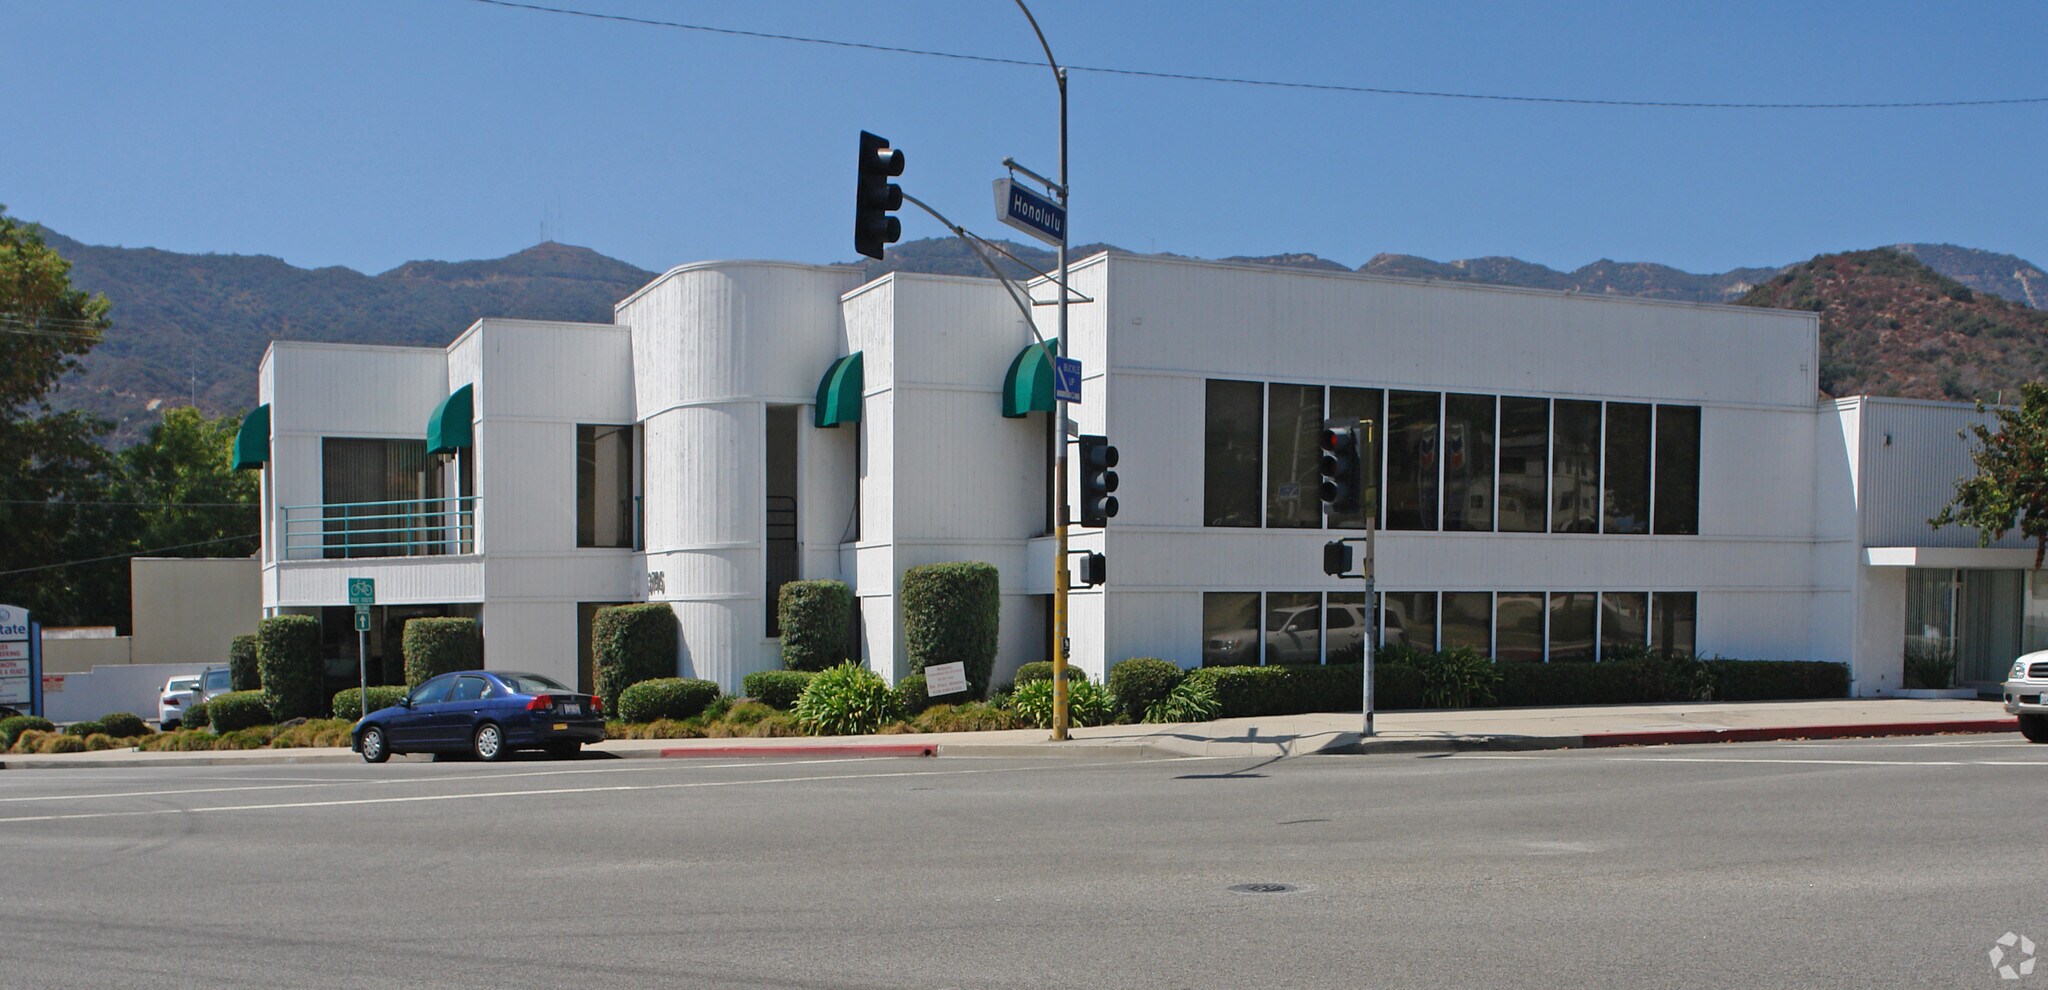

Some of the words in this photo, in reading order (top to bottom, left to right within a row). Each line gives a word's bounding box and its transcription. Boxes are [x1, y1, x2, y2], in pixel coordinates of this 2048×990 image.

[1014, 194, 1061, 232] Honolulu
[1063, 363, 1080, 375] BUCKLE
[1069, 377, 1075, 386] UP
[0, 624, 26, 635] tate
